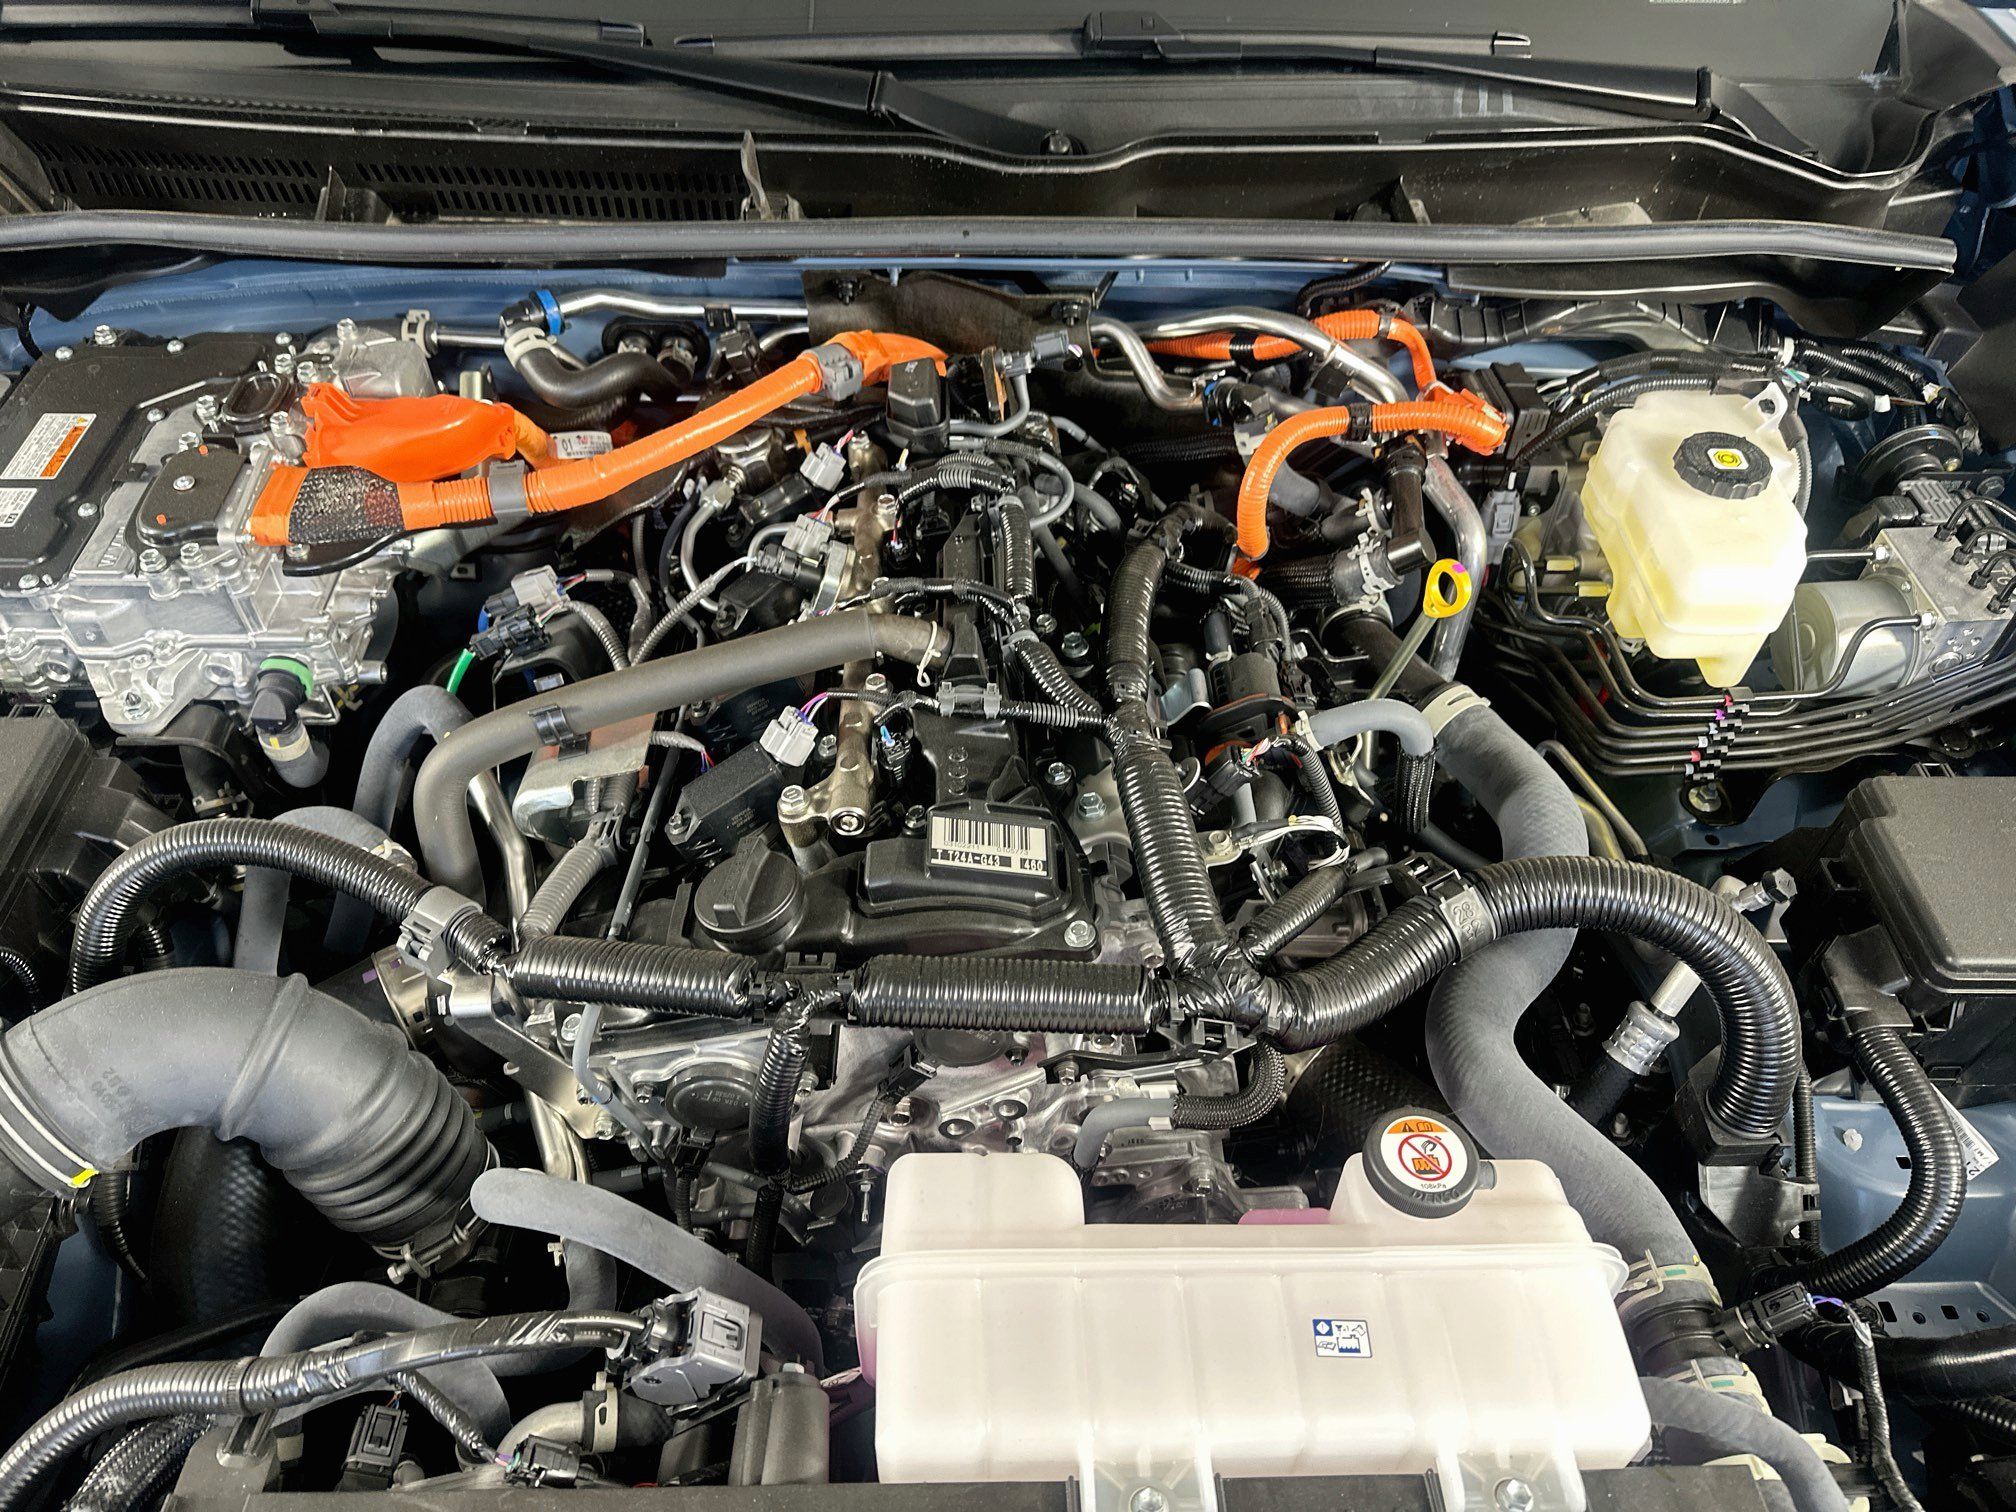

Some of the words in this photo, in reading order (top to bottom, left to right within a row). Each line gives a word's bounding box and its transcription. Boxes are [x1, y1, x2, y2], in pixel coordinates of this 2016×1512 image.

[936, 849, 943, 860] T
[1453, 901, 1474, 925] 28
[1412, 1188, 1460, 1204] DENSO
